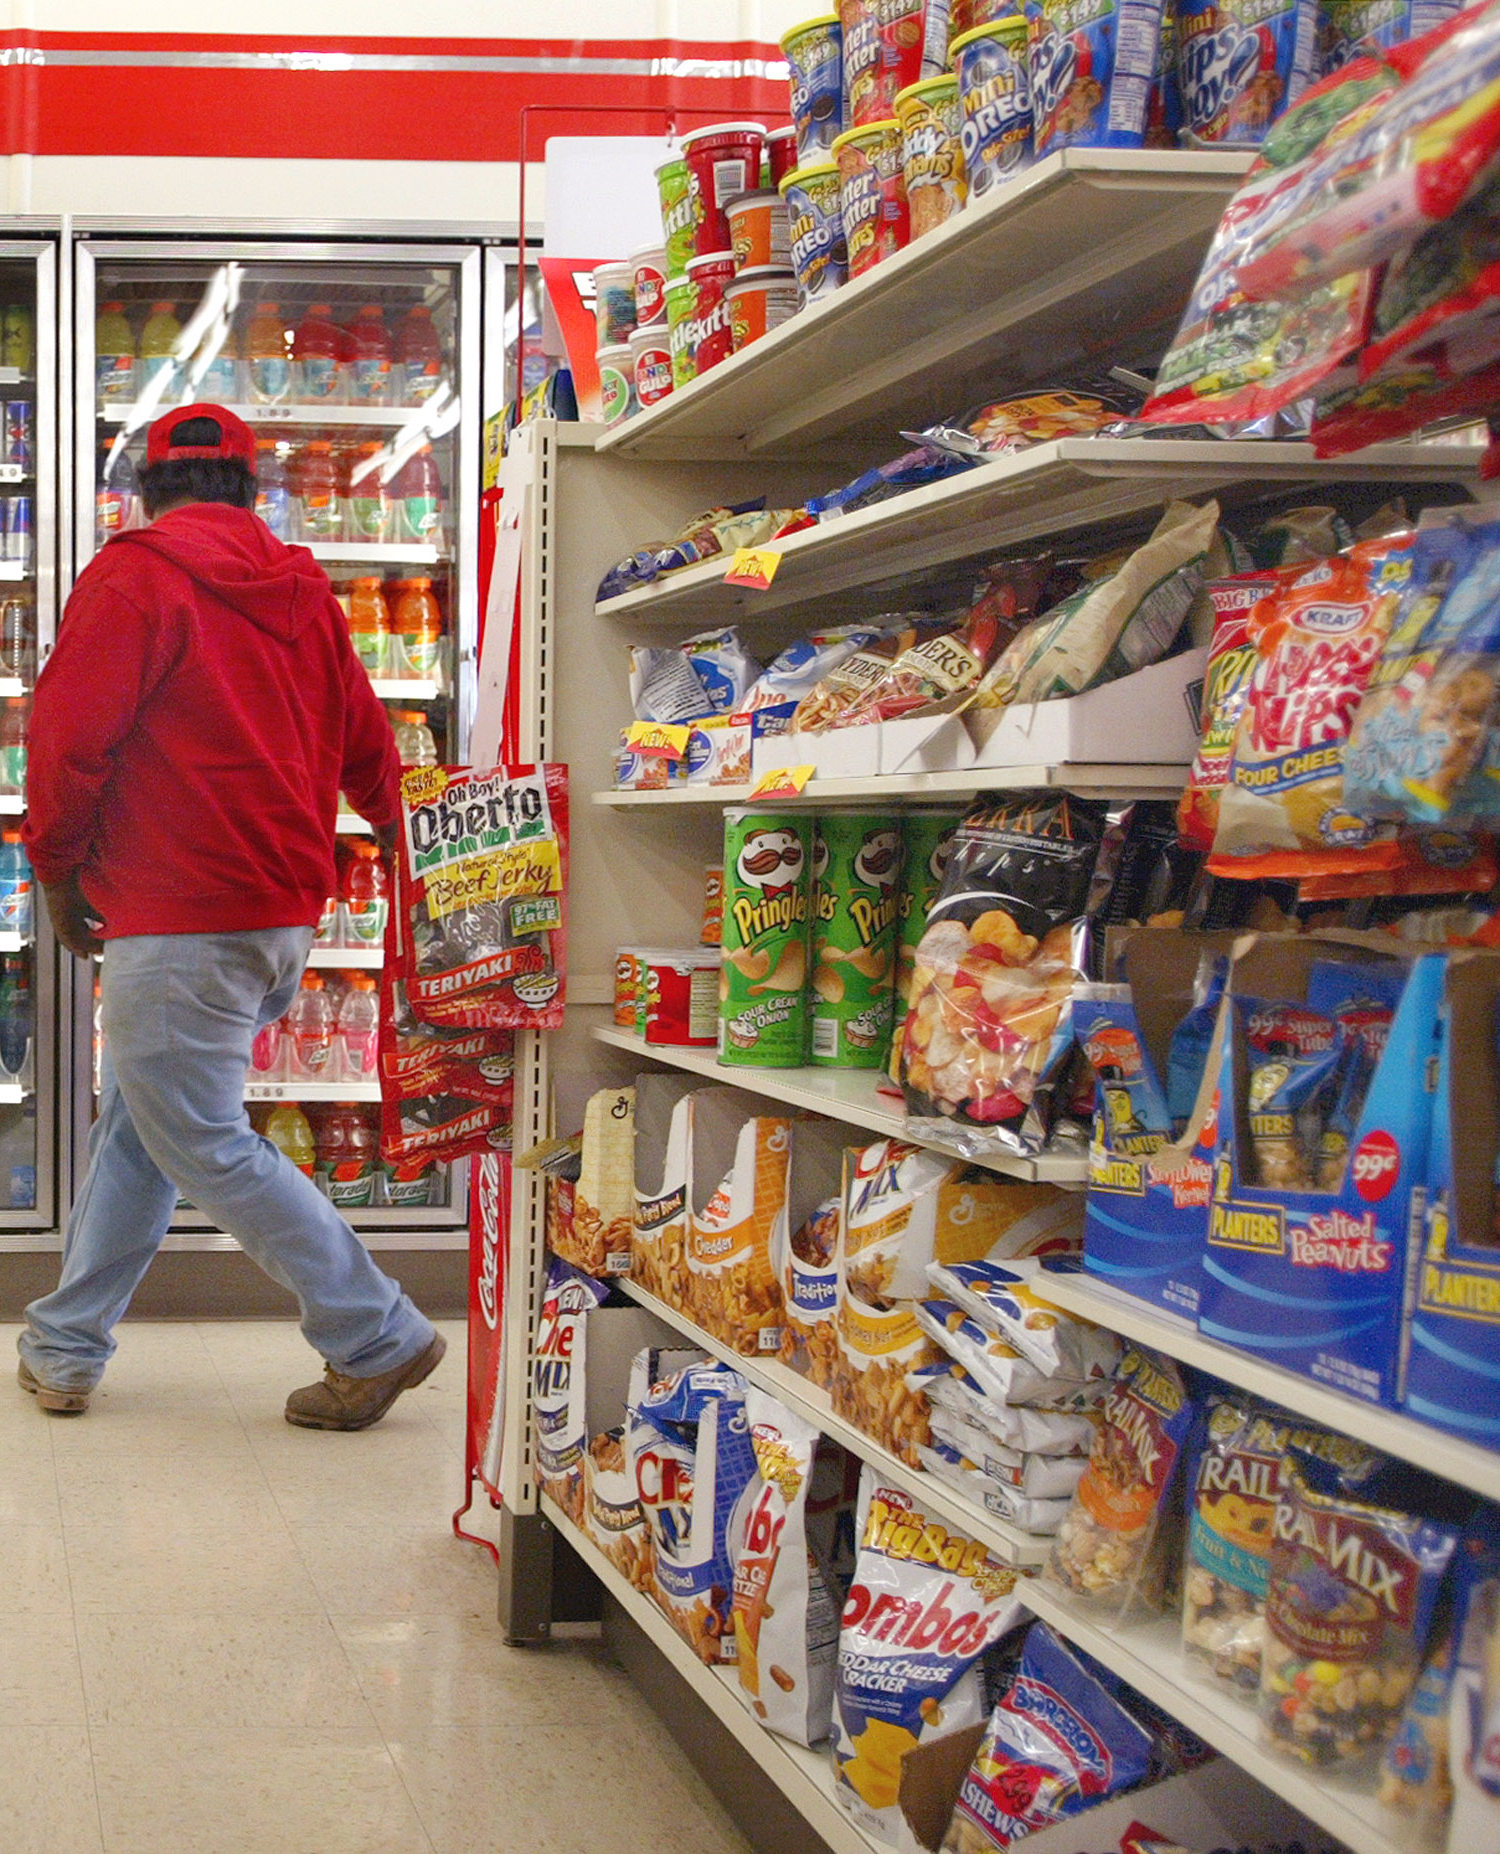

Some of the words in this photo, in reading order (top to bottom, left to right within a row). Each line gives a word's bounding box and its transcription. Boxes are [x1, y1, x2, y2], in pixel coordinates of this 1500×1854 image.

[961, 92, 1033, 161] OREO
[639, 373, 672, 395] GULP
[1213, 592, 1247, 611] BIG
[1306, 610, 1361, 626] KRAFT
[404, 770, 435, 788] GREAT
[448, 785, 467, 806] Oh
[468, 776, 500, 800] Boy!
[1235, 765, 1279, 786] FOUR
[410, 785, 544, 854] Oberto
[430, 867, 492, 907] Beef
[491, 861, 554, 896] Jerky
[515, 909, 557, 927] FREE
[536, 899, 555, 912] FAT
[419, 954, 514, 998] TERIYAKI
[737, 1004, 766, 1024] SOUR
[757, 1009, 791, 1028] ONION
[396, 1035, 485, 1072] TERIYAKI
[249, 1087, 284, 1097] 1.89
[402, 1107, 491, 1151] TERIYAKI
[1352, 1152, 1398, 1181] 99¢
[1212, 1204, 1280, 1245] PLANTERS
[1309, 1211, 1373, 1241] Salted
[477, 1153, 500, 1330] Coca-Cola
[695, 1235, 733, 1257] Cheddar
[1290, 1230, 1392, 1271] Peanuts
[794, 1273, 837, 1303] Traditio
[1423, 1265, 1500, 1308] PLANTER
[1202, 1456, 1281, 1501] RAIL
[1274, 1503, 1328, 1555] RAIL
[1327, 1520, 1404, 1613] MIX
[841, 1581, 1001, 1658] ombos
[841, 1650, 890, 1674] EDDAR
[889, 1658, 953, 1684] CHEESE
[963, 1780, 1029, 1840] SHEWS
